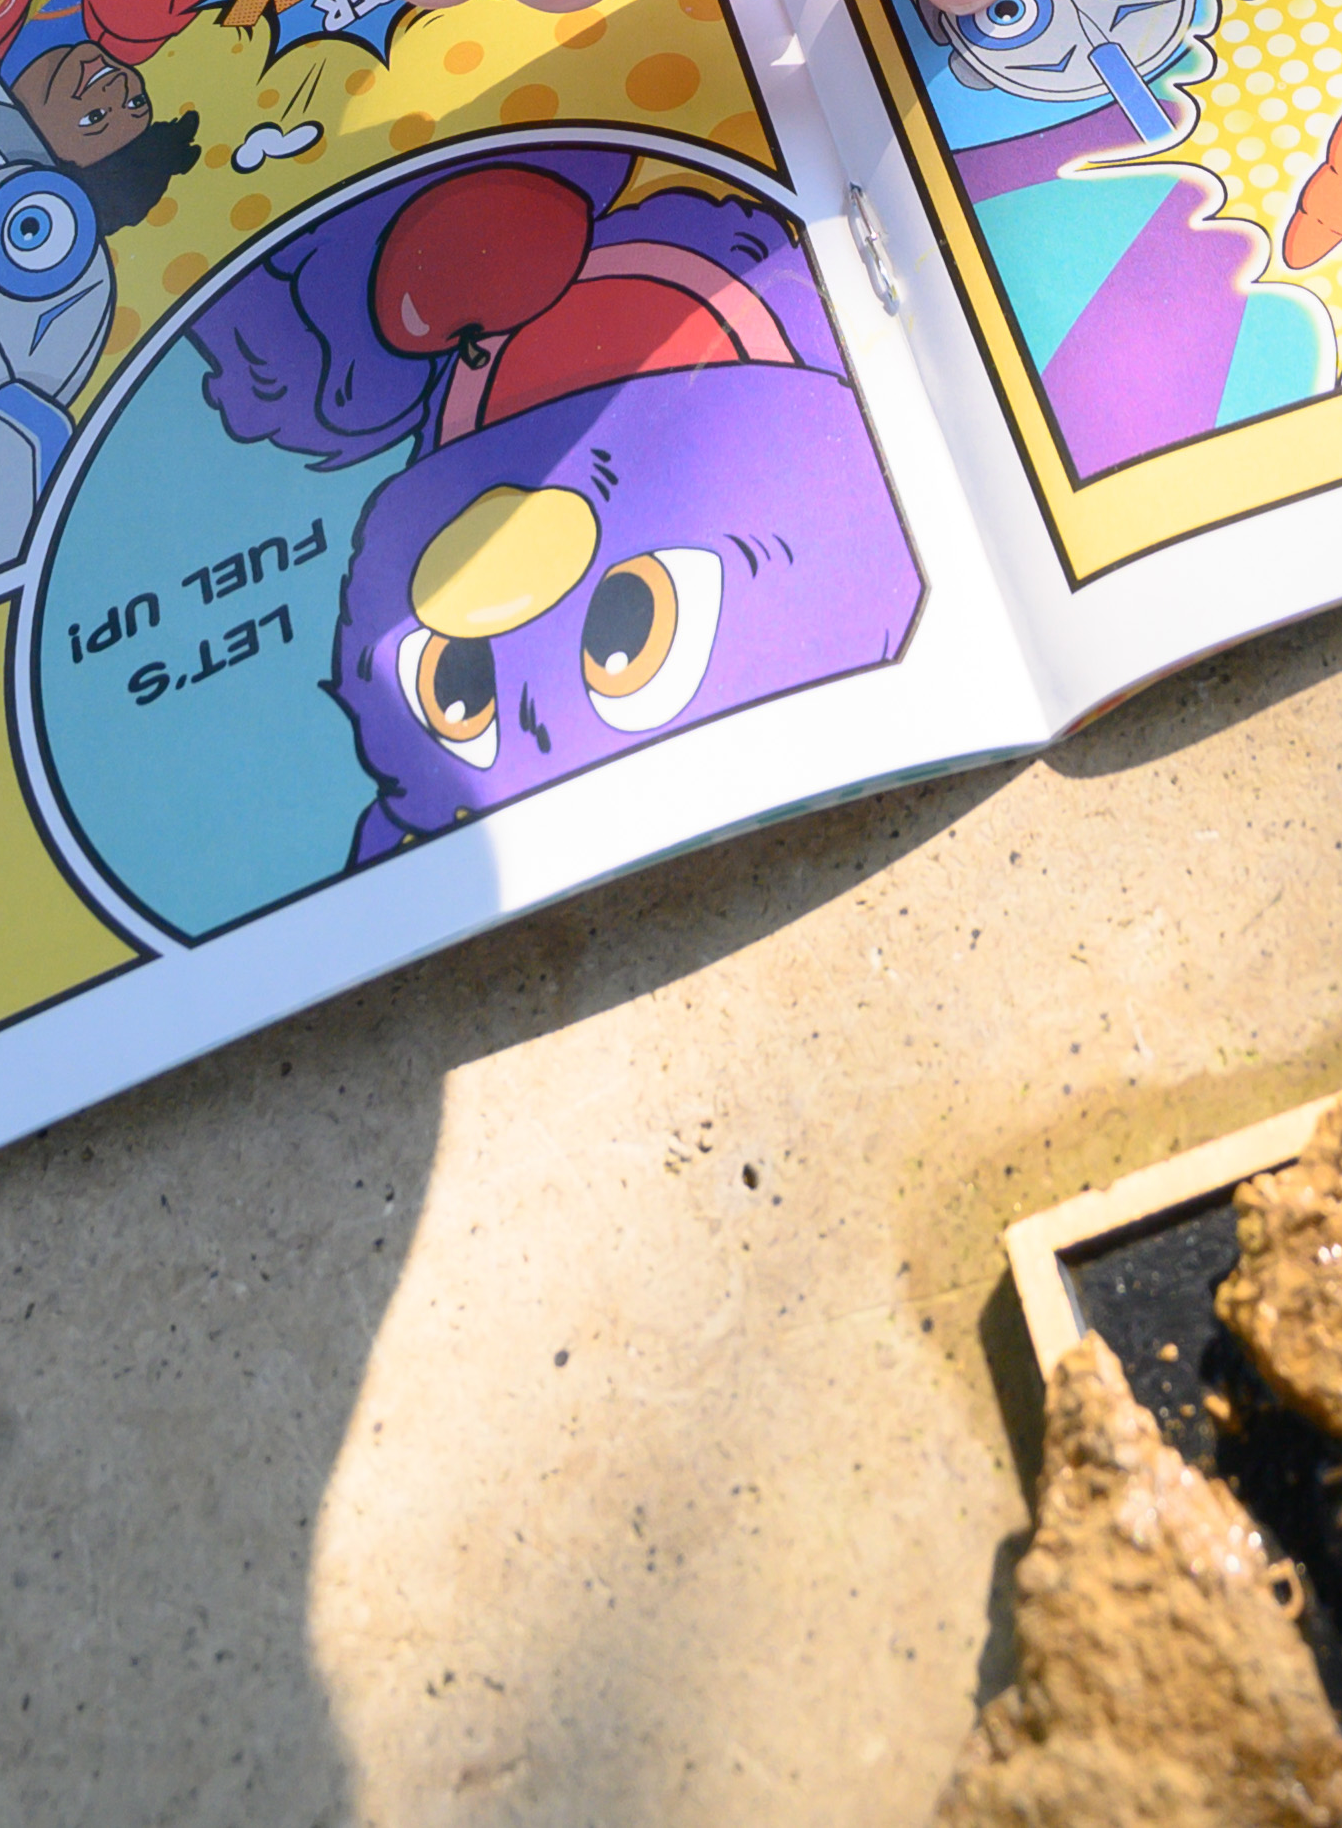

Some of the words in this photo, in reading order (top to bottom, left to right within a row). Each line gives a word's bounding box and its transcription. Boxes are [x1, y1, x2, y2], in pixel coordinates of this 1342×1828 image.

[181, 518, 329, 603] FUEL
[68, 591, 160, 665] UP!
[126, 604, 294, 707] LET'S
